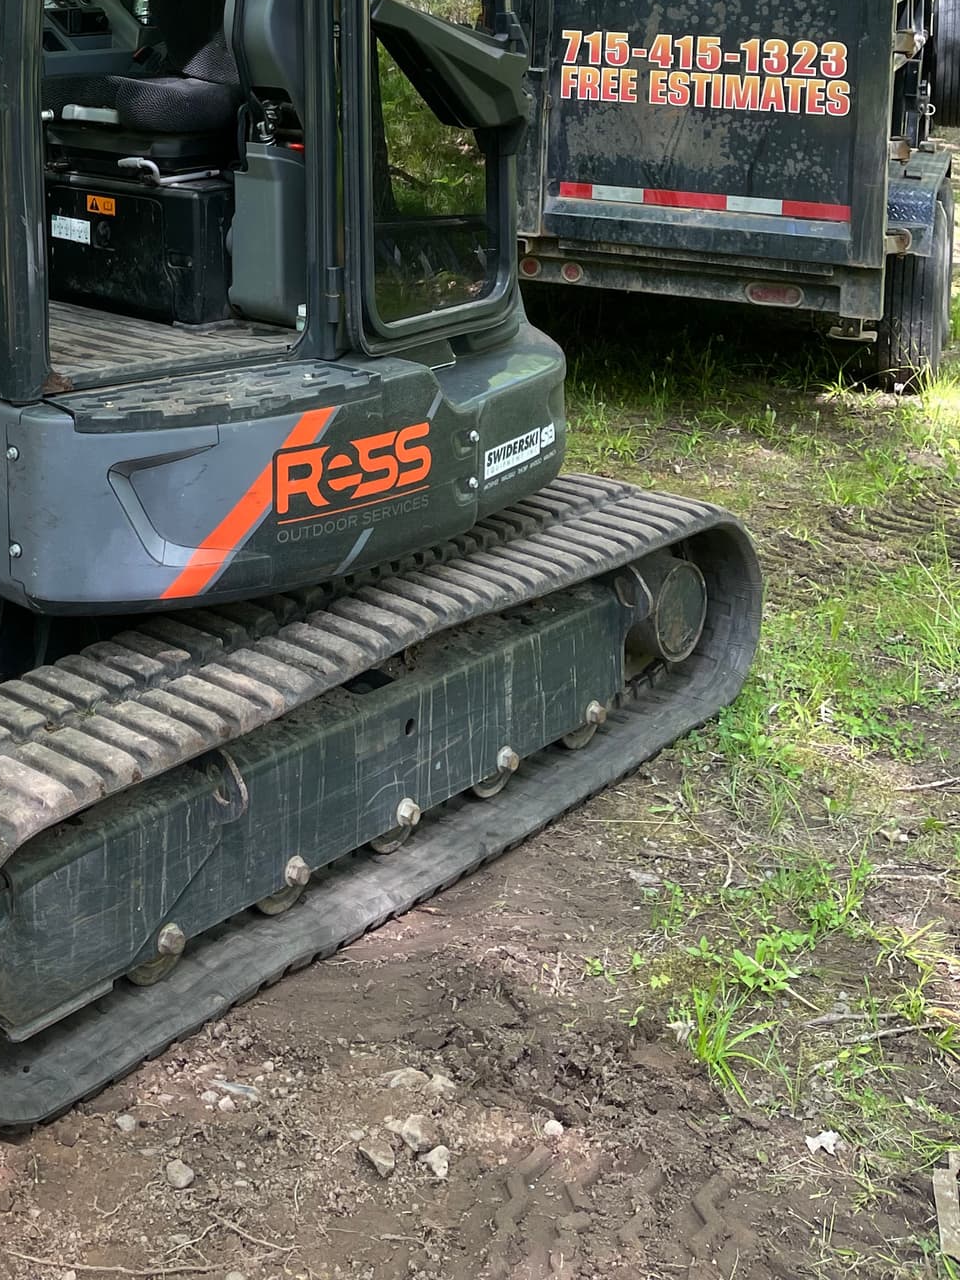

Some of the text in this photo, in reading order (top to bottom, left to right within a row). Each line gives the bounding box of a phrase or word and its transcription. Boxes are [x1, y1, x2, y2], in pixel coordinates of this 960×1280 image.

[561, 30, 848, 78] 715-415-1323
[560, 66, 851, 117] FREE ESTIMATES
[486, 430, 539, 468] SWIDERSKI
[276, 494, 430, 543] OUTDOOR SERVICES
